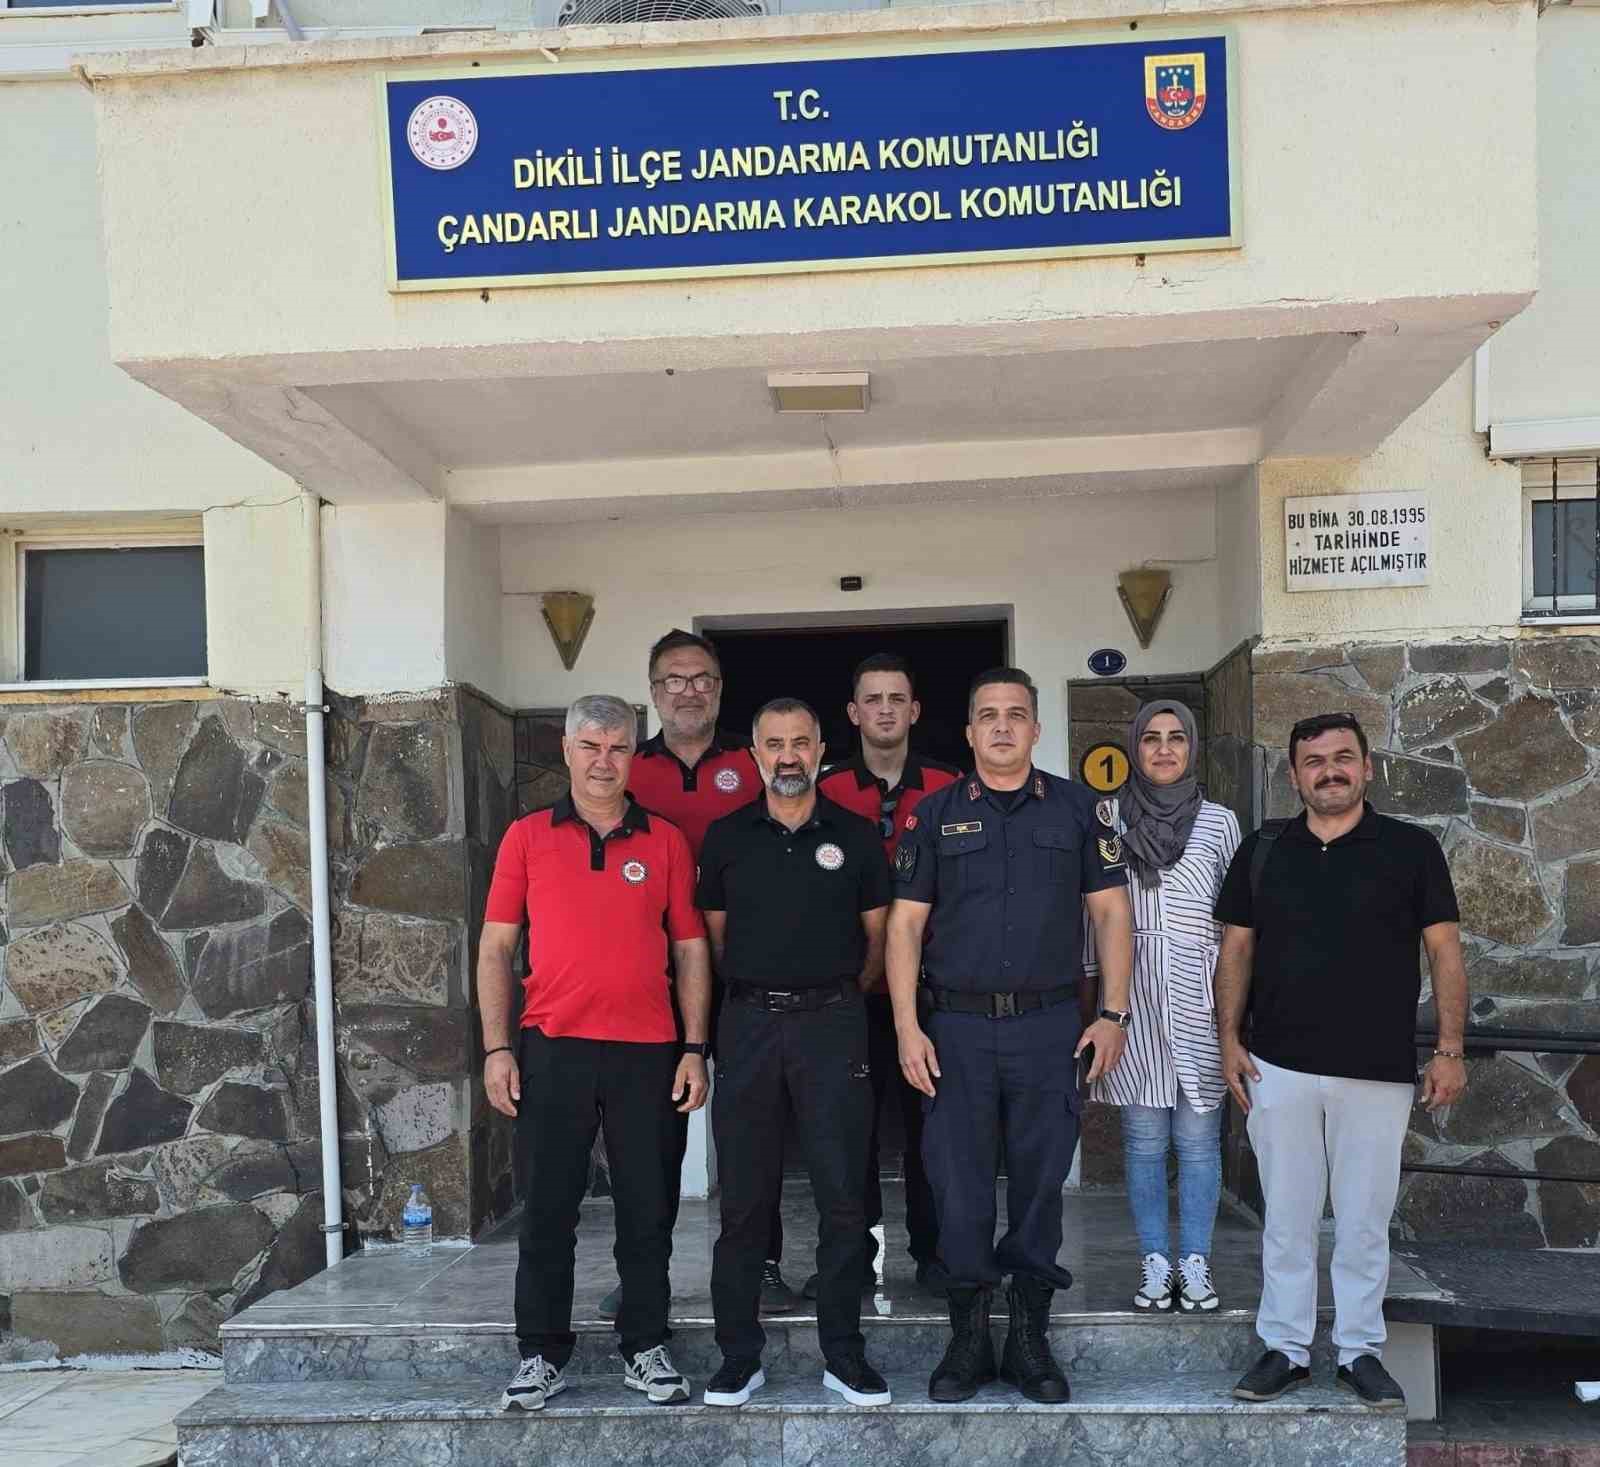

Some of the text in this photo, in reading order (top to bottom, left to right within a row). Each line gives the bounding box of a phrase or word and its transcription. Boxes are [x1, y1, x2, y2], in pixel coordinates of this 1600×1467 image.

[773, 88, 830, 121] T.C.
[513, 119, 1098, 189] DİKİLİ İLÇE JANDARMA KOMUTANLIĞI
[437, 168, 1181, 253] ÇANDARLI JANDARMA KARAKOL KOMUTANLIĞI
[1288, 507, 1426, 529] BU BİNA 30.08.1995
[1315, 530, 1401, 551] TARİHİNDE
[1289, 553, 1427, 576] HİZMETE AÇILMIŞTIR
[1104, 655, 1110, 667] 1
[1100, 754, 1115, 783] 1
